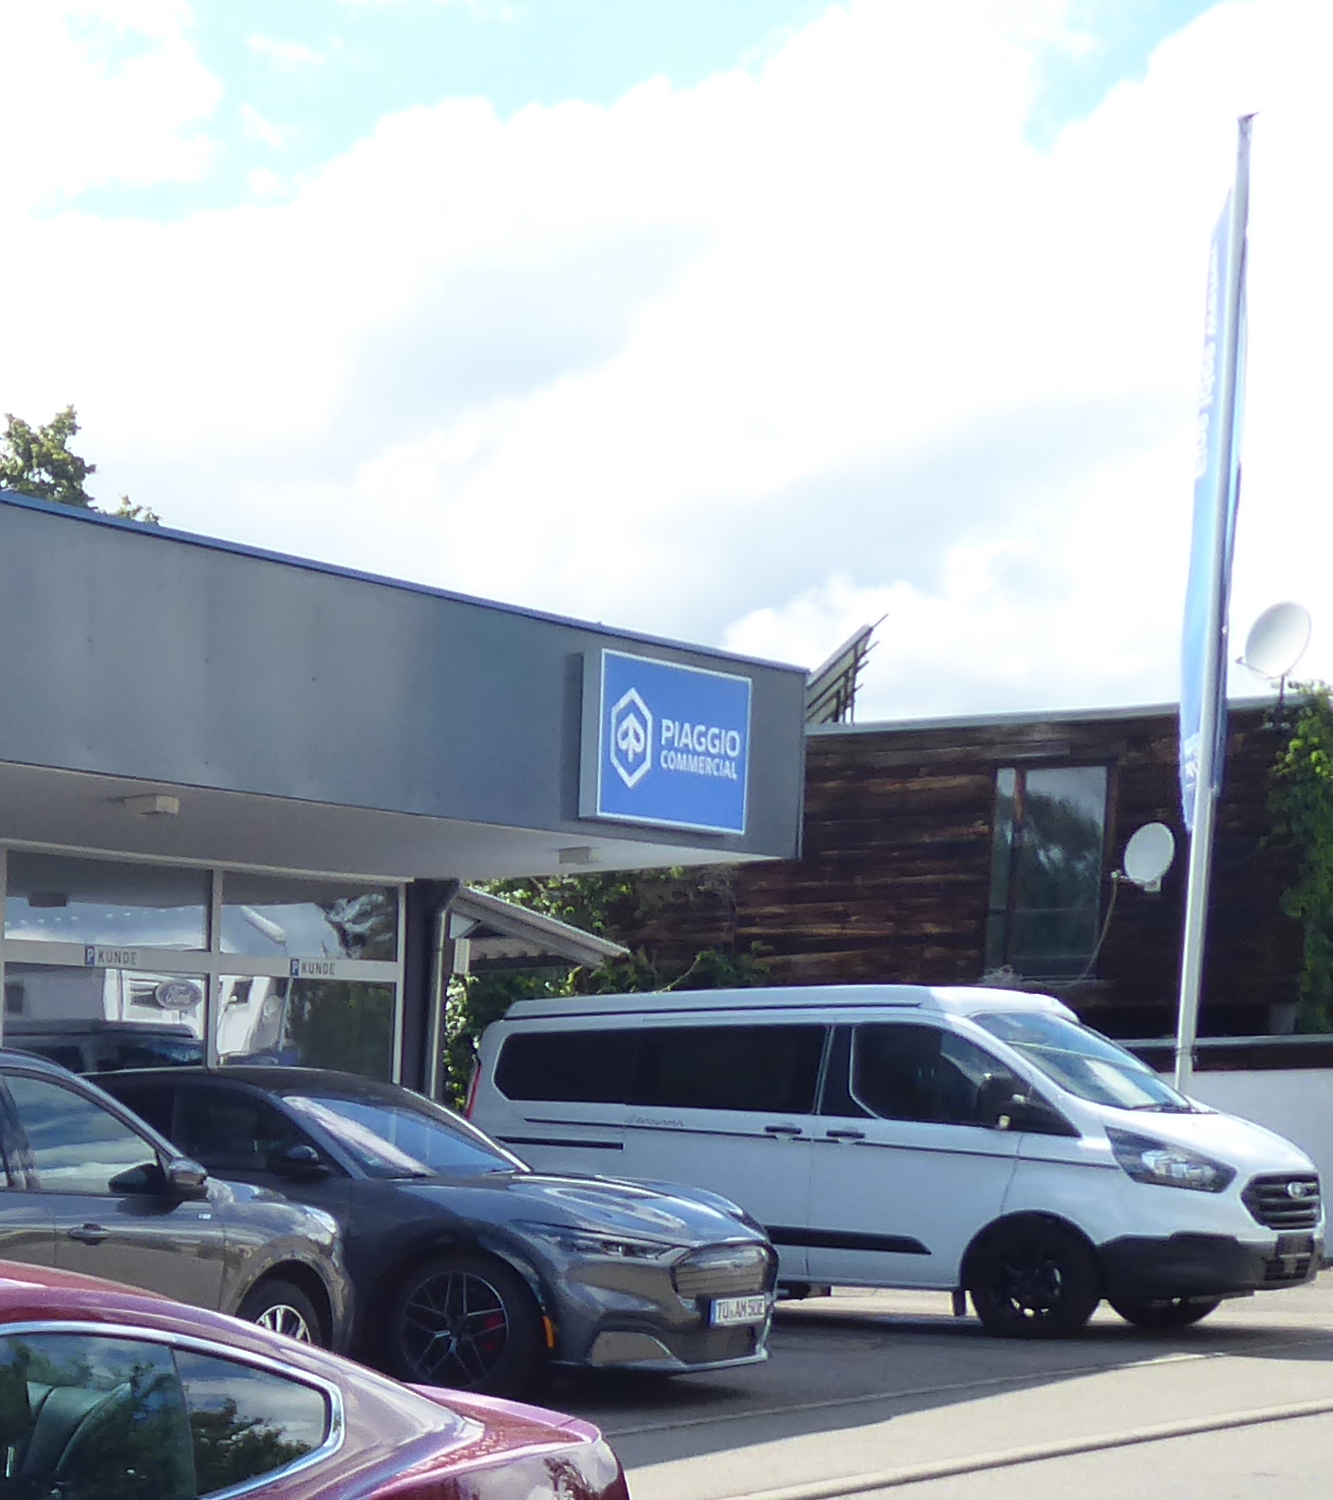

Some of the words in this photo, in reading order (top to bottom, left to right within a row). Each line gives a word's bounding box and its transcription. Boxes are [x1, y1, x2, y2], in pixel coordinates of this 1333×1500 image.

[660, 718, 742, 758] PIAGGIO
[660, 749, 738, 781] COMMERCIAL
[97, 950, 138, 966] KUNDE
[301, 961, 336, 976] KUNDE
